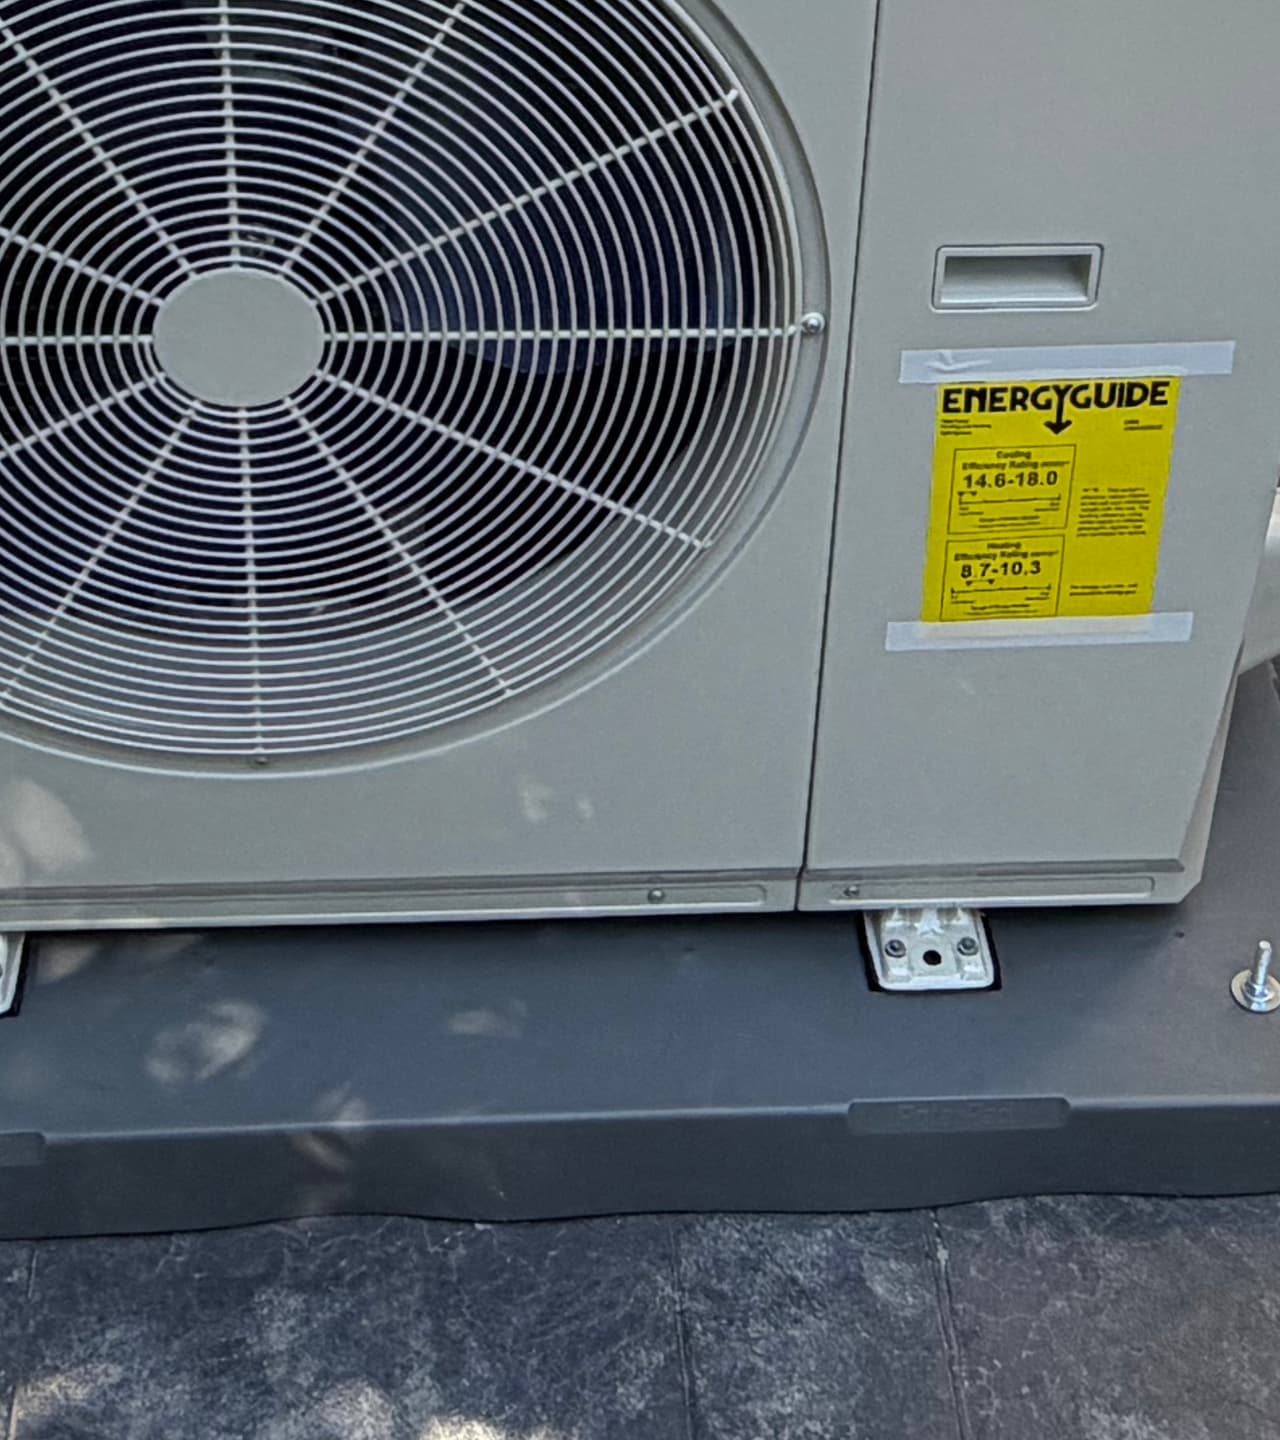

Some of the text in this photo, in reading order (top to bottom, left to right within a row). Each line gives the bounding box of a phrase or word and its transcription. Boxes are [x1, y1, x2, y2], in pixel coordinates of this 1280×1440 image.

[942, 380, 1170, 414] ENERGYGUIDE
[996, 450, 1032, 460] Cooling
[963, 470, 1058, 489] 14.6-18.0
